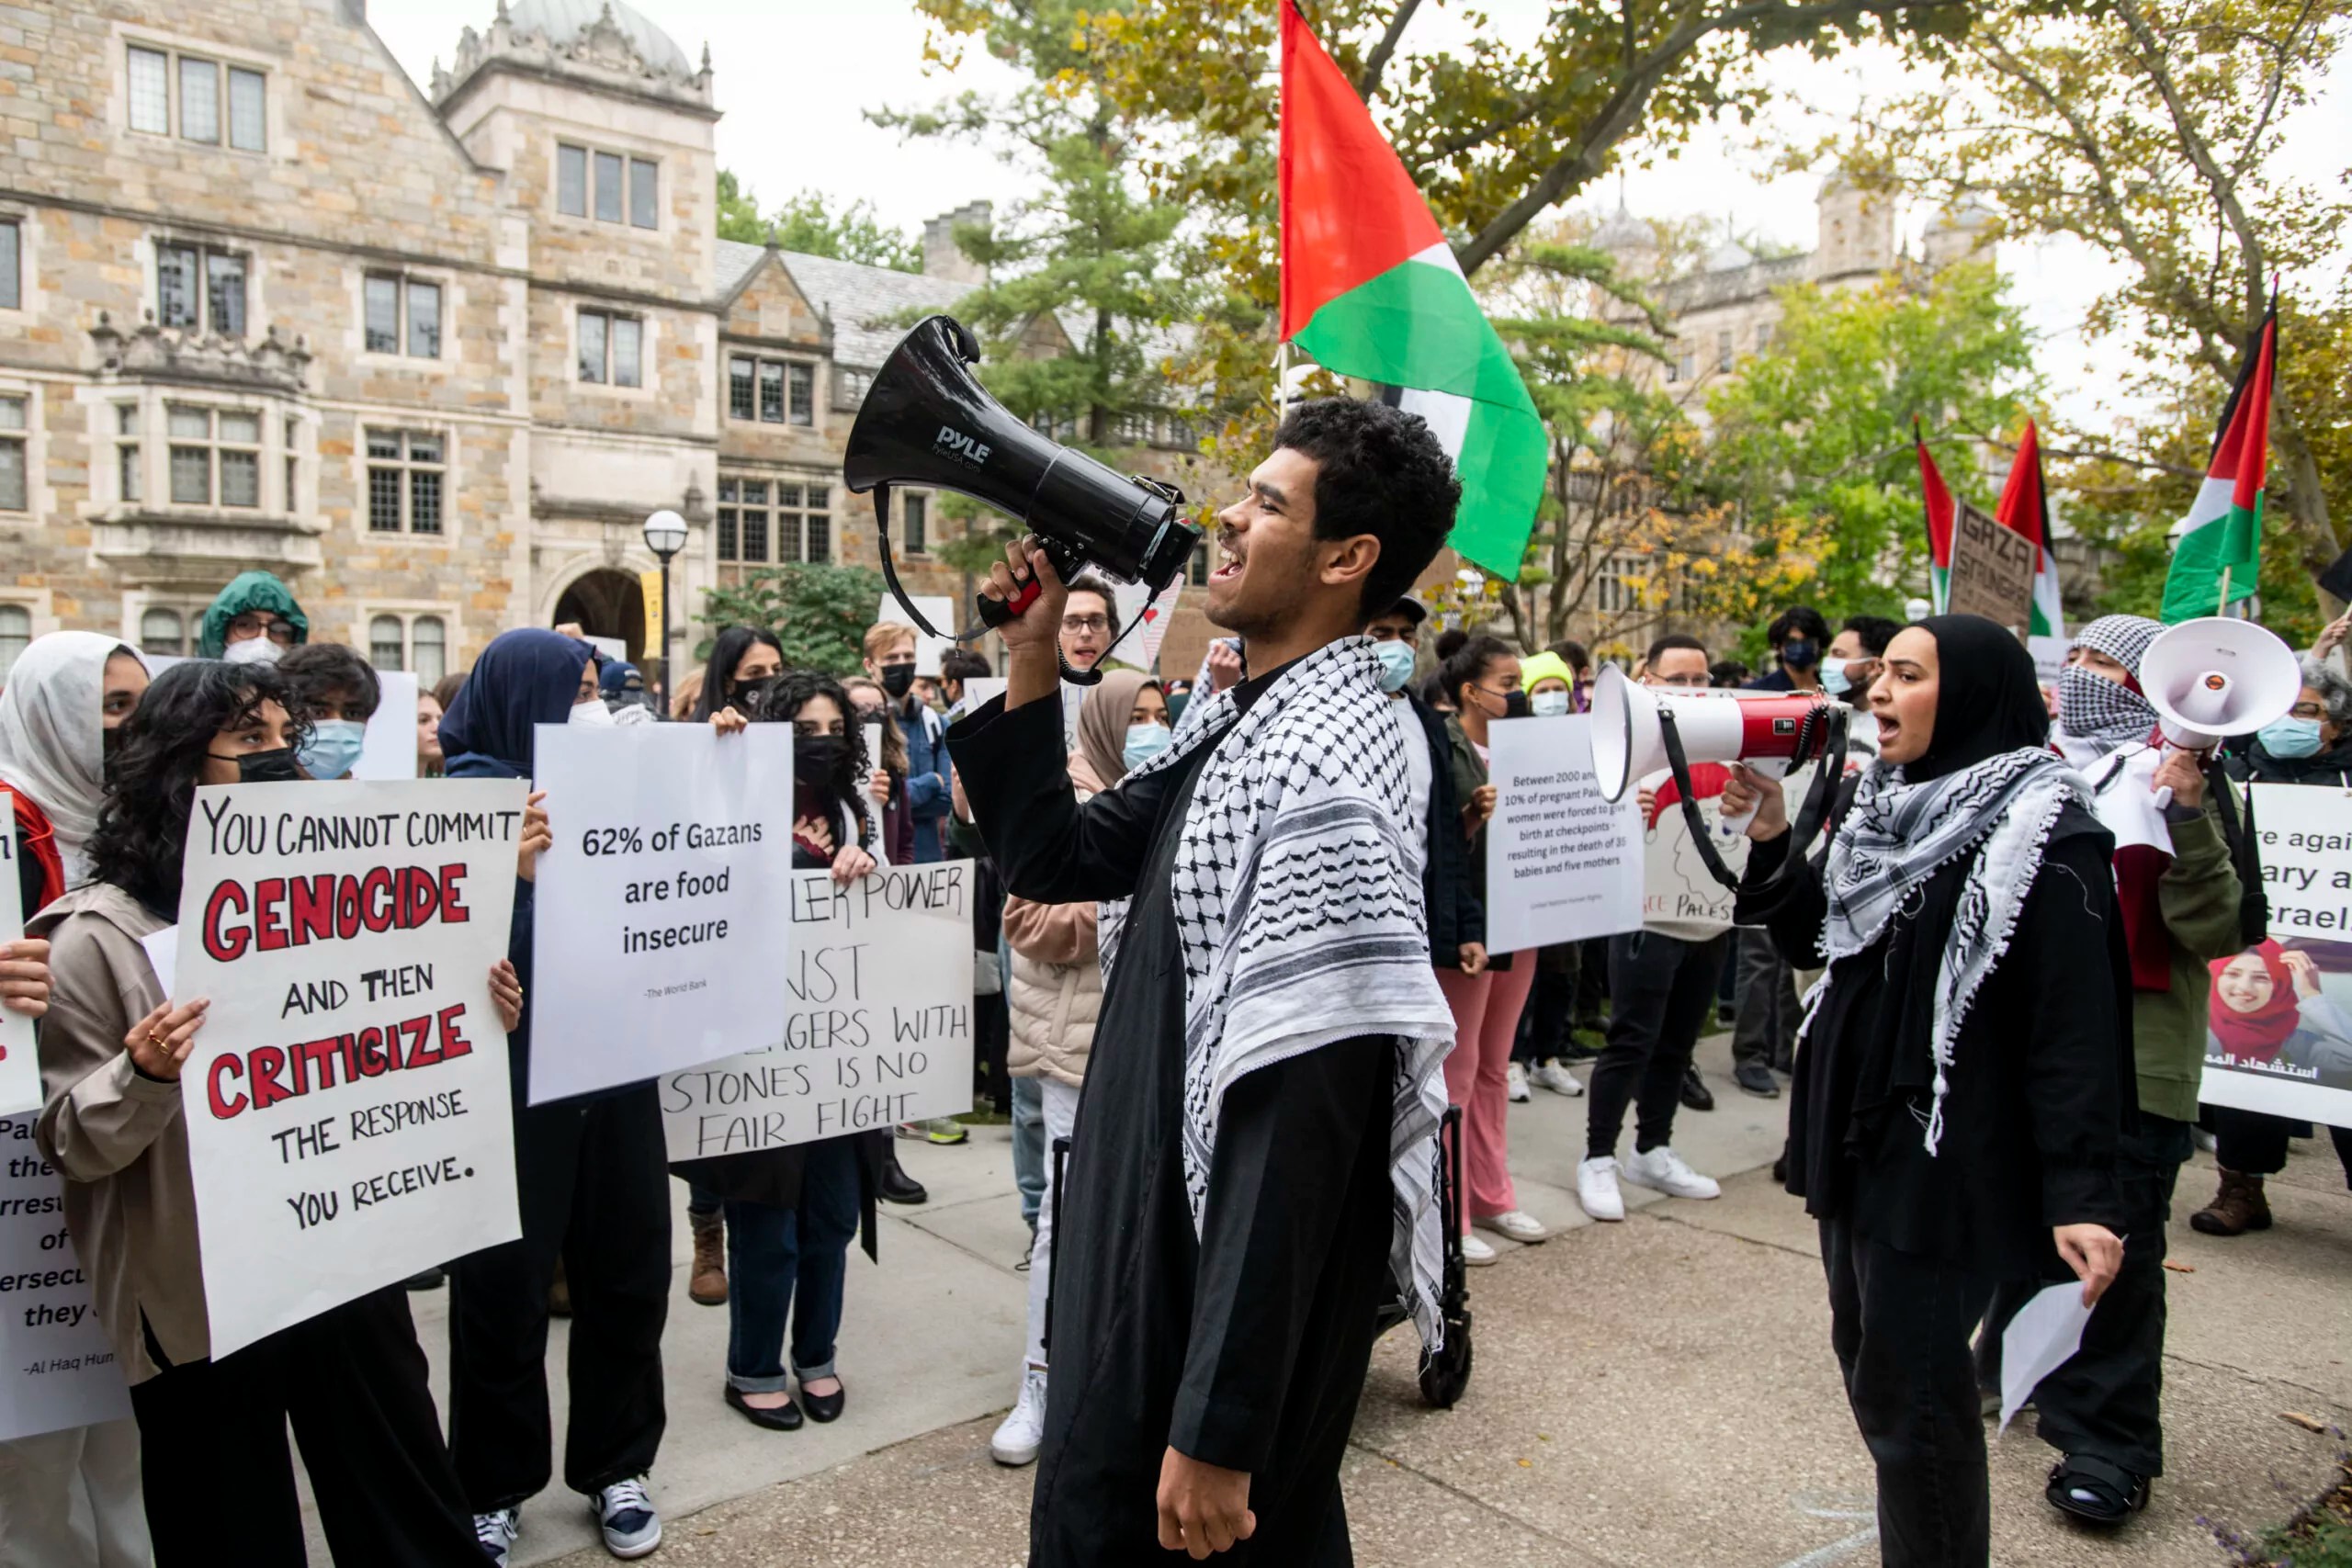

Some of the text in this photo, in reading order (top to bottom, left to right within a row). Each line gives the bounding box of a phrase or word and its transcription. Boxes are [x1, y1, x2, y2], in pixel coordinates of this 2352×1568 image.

[936, 425, 990, 464] PYLE
[1962, 504, 2030, 575] GAZA
[1505, 795, 1525, 807] 10%
[1528, 792, 1538, 804] of
[1540, 789, 1580, 806] pregnant
[1513, 775, 1554, 787] Between
[1556, 771, 1580, 783] 2000
[201, 795, 520, 855] YOU CANNOT COMMIT
[1508, 812, 1541, 824] women
[1544, 810, 1566, 820] were
[1567, 806, 1597, 818] forced
[1599, 805, 1608, 814] to
[1520, 828, 1543, 841] birth
[1544, 828, 1553, 838] at
[1555, 822, 1610, 837] checkpoints
[582, 822, 762, 856] 62% of Gazans
[1507, 846, 1547, 861] resulting
[1550, 844, 1558, 855] in
[1560, 842, 1575, 854] the
[1577, 840, 1603, 852] death
[1605, 837, 1614, 849] of
[625, 865, 729, 904] are food
[1514, 856, 1620, 879] babies and five mothers
[864, 866, 964, 919] POWER
[202, 863, 469, 962] GENOCIDE
[624, 919, 728, 953] insecure
[281, 963, 434, 1020] AND THEN
[784, 1005, 967, 1051] GERS WITH
[207, 1002, 472, 1120] CRITICIZE
[663, 1052, 927, 1113] STONES IS NO
[271, 1089, 469, 1163] THE RESPONSE
[697, 1111, 786, 1156] FAIR
[287, 1156, 474, 1230] YOU RECEIVE.
[40, 1227, 70, 1250] of
[25, 1303, 87, 1327] they
[50, 1359, 80, 1371] Haq
